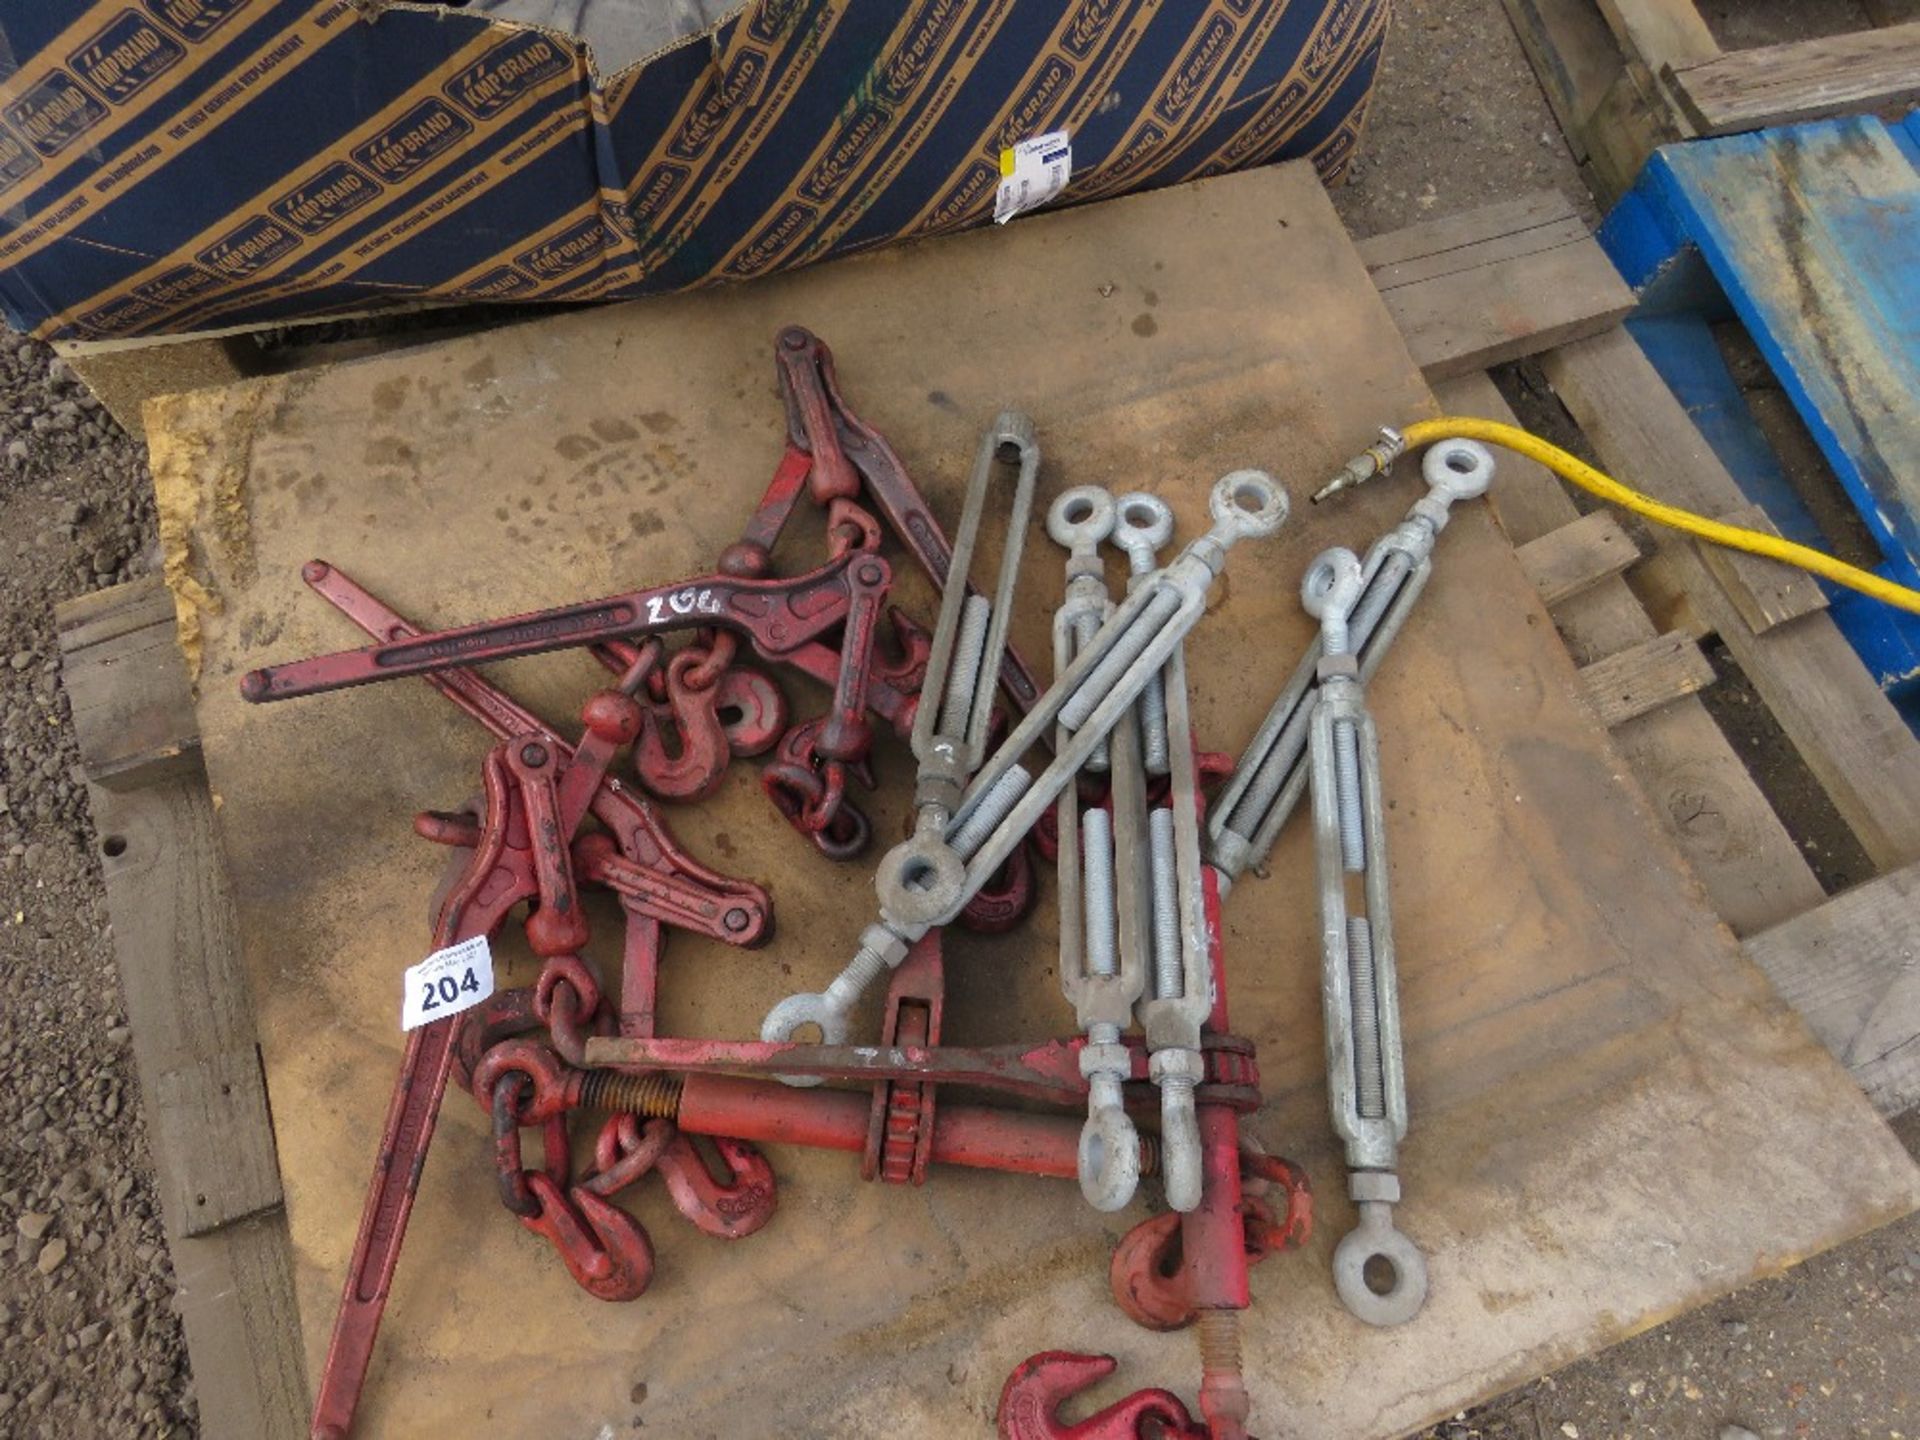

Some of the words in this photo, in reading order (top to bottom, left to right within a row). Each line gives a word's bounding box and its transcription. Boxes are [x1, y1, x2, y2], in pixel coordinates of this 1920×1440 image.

[88, 57, 124, 91] KMP
[111, 28, 161, 70] BRAND
[238, 34, 305, 88] REPLACEMENT
[462, 73, 503, 108] KMP
[496, 42, 552, 83] BRAND
[887, 52, 916, 96] KMP
[1188, 24, 1224, 80] BRAND
[1022, 66, 1061, 120] BRAND
[370, 143, 407, 175] KMP
[400, 111, 453, 153] BRAND
[681, 114, 711, 154] KMP
[836, 112, 878, 164] BRAND
[288, 200, 323, 226] KMP
[315, 173, 363, 208] BRAND
[947, 168, 987, 216] BRAND
[216, 254, 245, 274] KMP
[240, 226, 284, 260] BRAND
[530, 251, 562, 274] KMP
[558, 224, 605, 260] BRAND
[762, 209, 803, 251] BRAND
[422, 966, 481, 1013] 204
